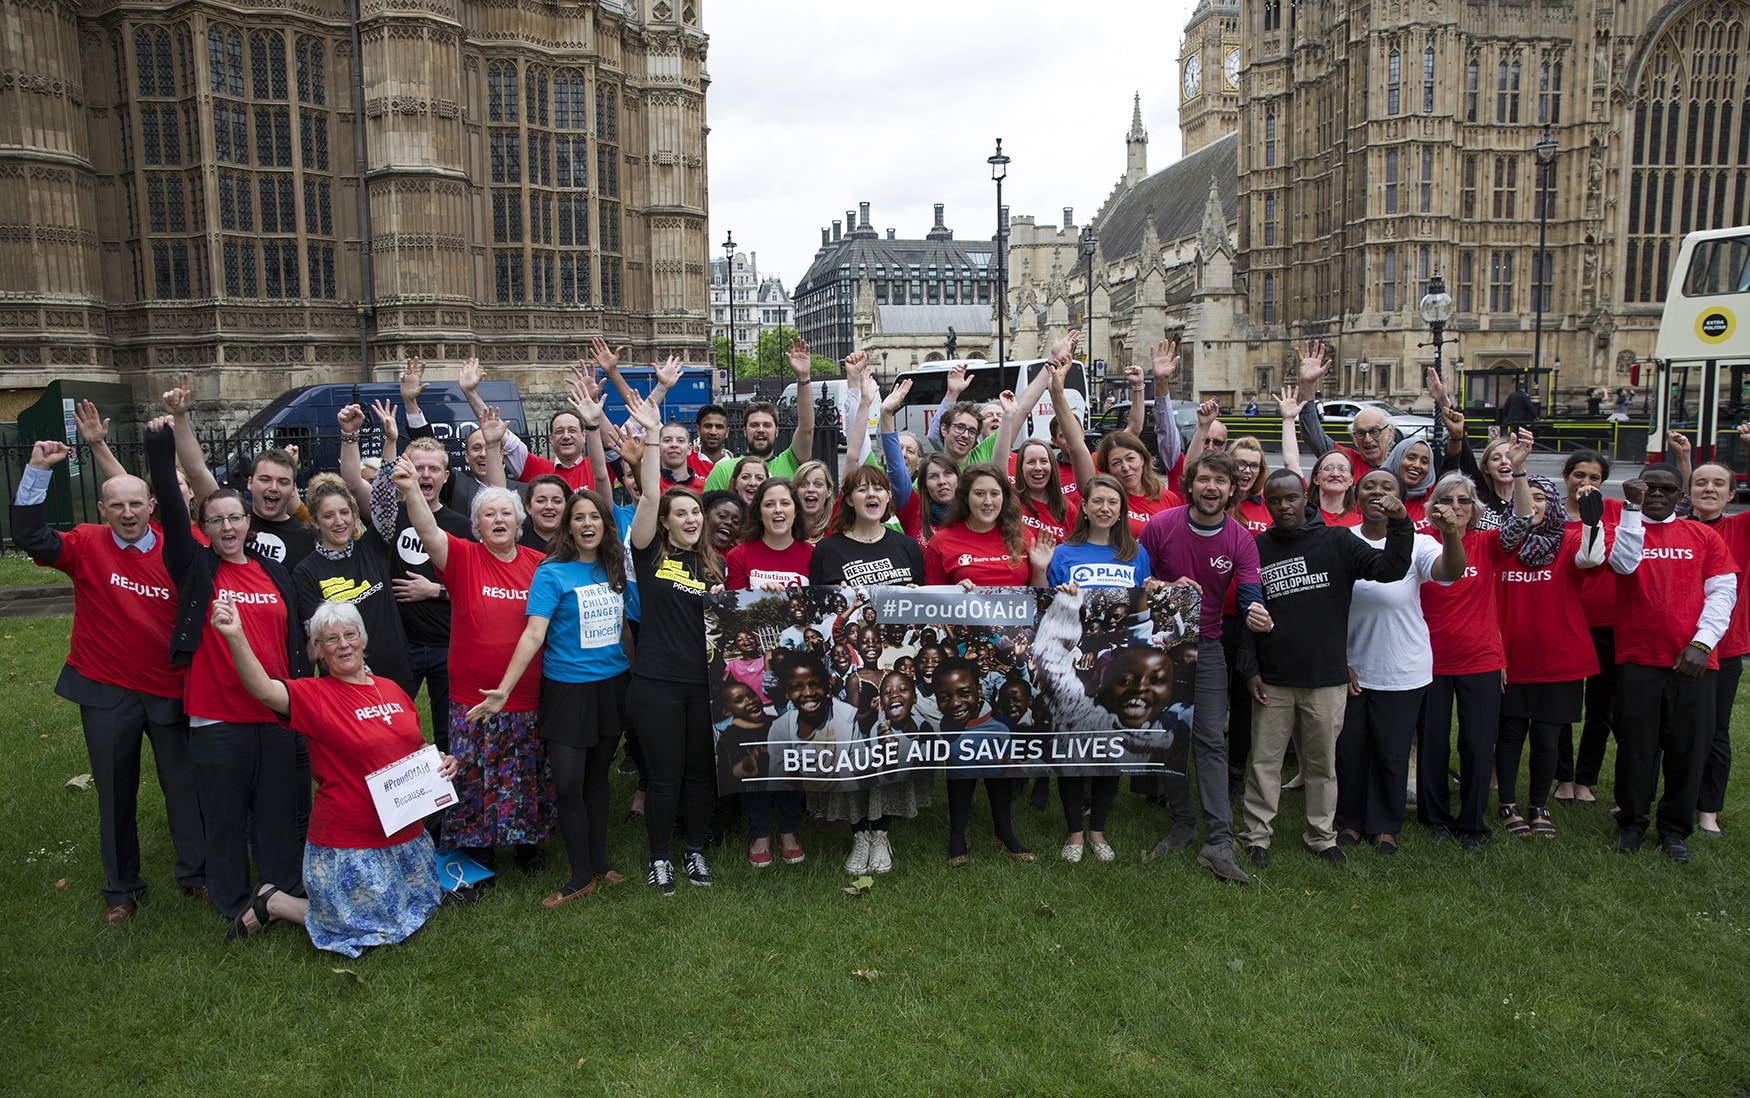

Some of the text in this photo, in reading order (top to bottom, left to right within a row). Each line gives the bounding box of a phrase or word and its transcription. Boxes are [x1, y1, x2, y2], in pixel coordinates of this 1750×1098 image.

[1642, 548, 1693, 559] ESULTS
[846, 560, 891, 578] RESTLESS
[850, 567, 912, 586] DEVELOPMENT
[1097, 568, 1131, 580] PLAN
[1262, 563, 1305, 583] RESTLESS
[1501, 570, 1552, 582] RESULTS
[1266, 572, 1329, 595] DEVELOPMENT
[218, 588, 278, 604] RESULTS
[482, 586, 528, 600] RESULT
[582, 595, 620, 608] CHILD IN
[883, 600, 1028, 619] #ProudOfAid
[584, 623, 617, 638] unicef
[783, 737, 1125, 773] BECAUSE AID SAVES LIVES
[383, 762, 431, 792] #ProudOfAid
